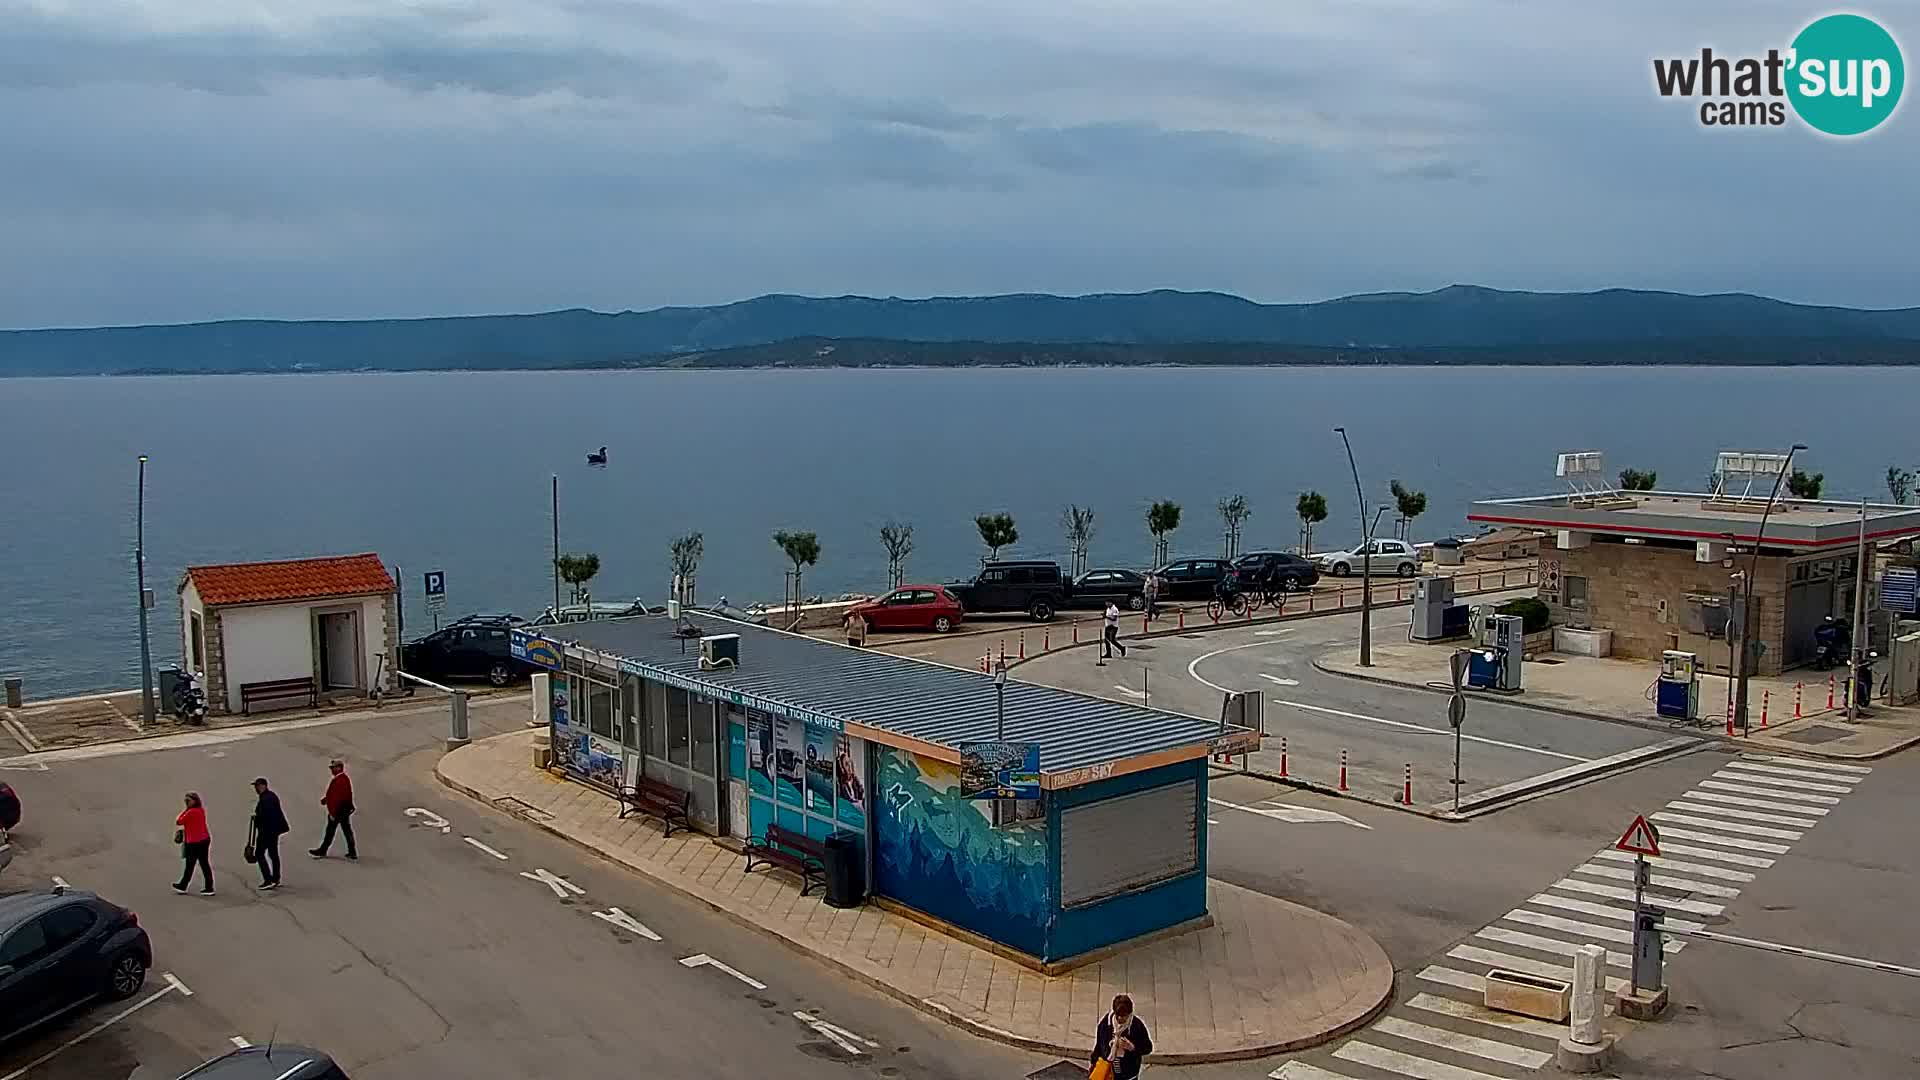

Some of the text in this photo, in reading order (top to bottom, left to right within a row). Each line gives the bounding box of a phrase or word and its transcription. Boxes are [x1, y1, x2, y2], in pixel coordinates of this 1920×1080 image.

[742, 695, 756, 707] BUS
[756, 699, 787, 716] STATION
[789, 708, 814, 722] TICKET
[815, 716, 841, 730] OFFICE
